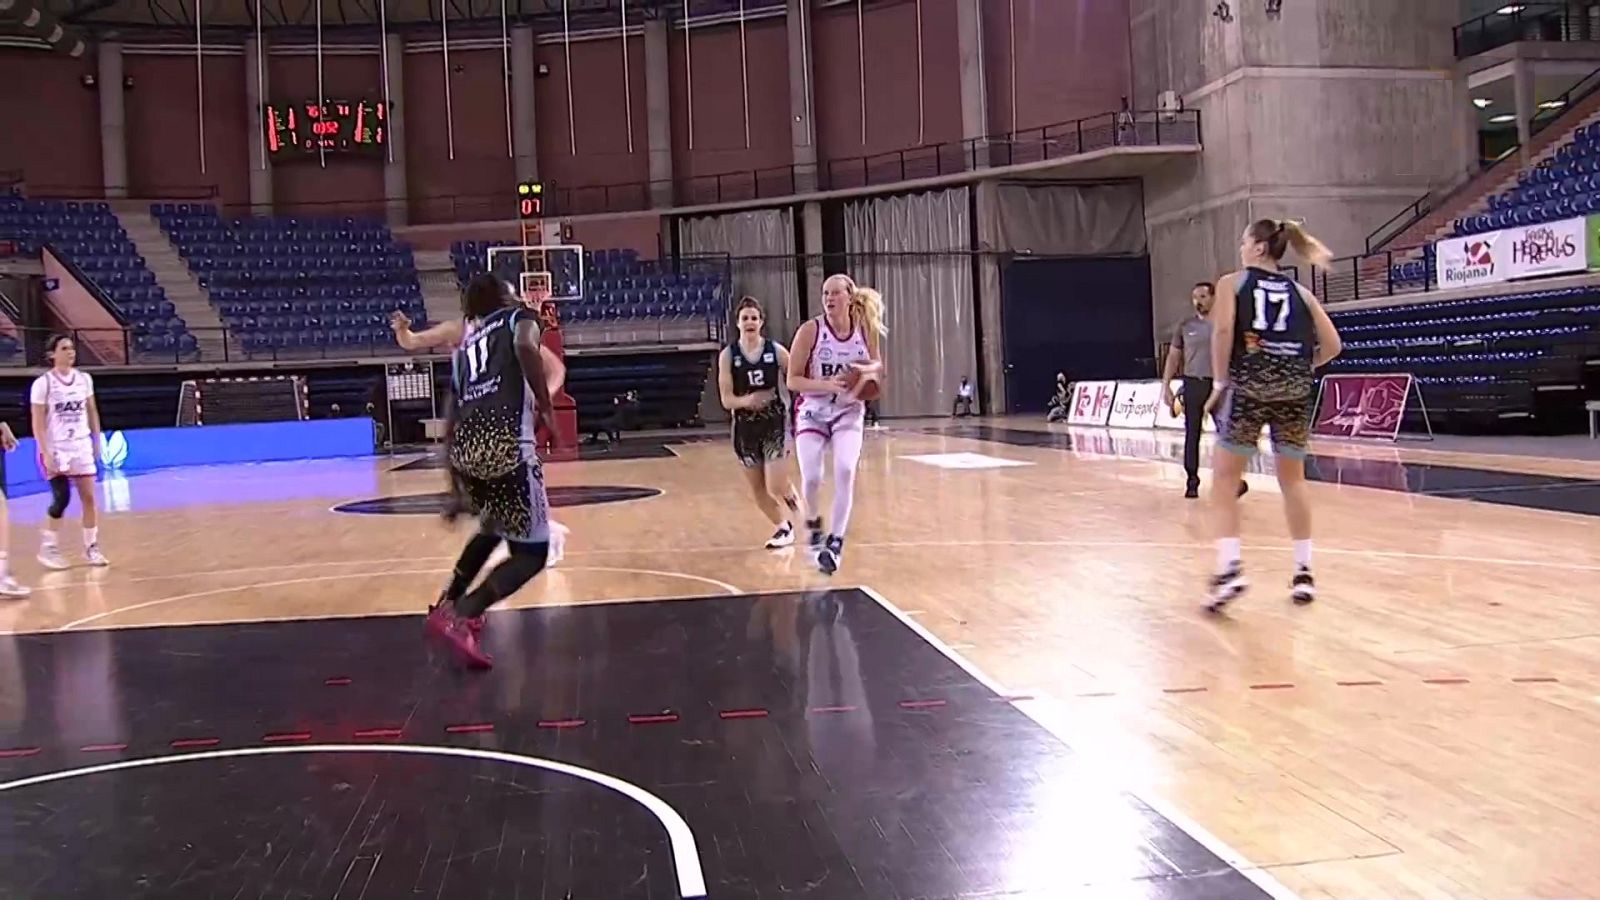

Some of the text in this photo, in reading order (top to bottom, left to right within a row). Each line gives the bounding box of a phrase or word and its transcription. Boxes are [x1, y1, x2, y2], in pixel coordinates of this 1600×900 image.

[521, 198, 540, 215] 07
[1445, 267, 1488, 284] Riojana
[1252, 288, 1291, 331] 17
[466, 338, 489, 382] 11
[747, 369, 765, 386] 12
